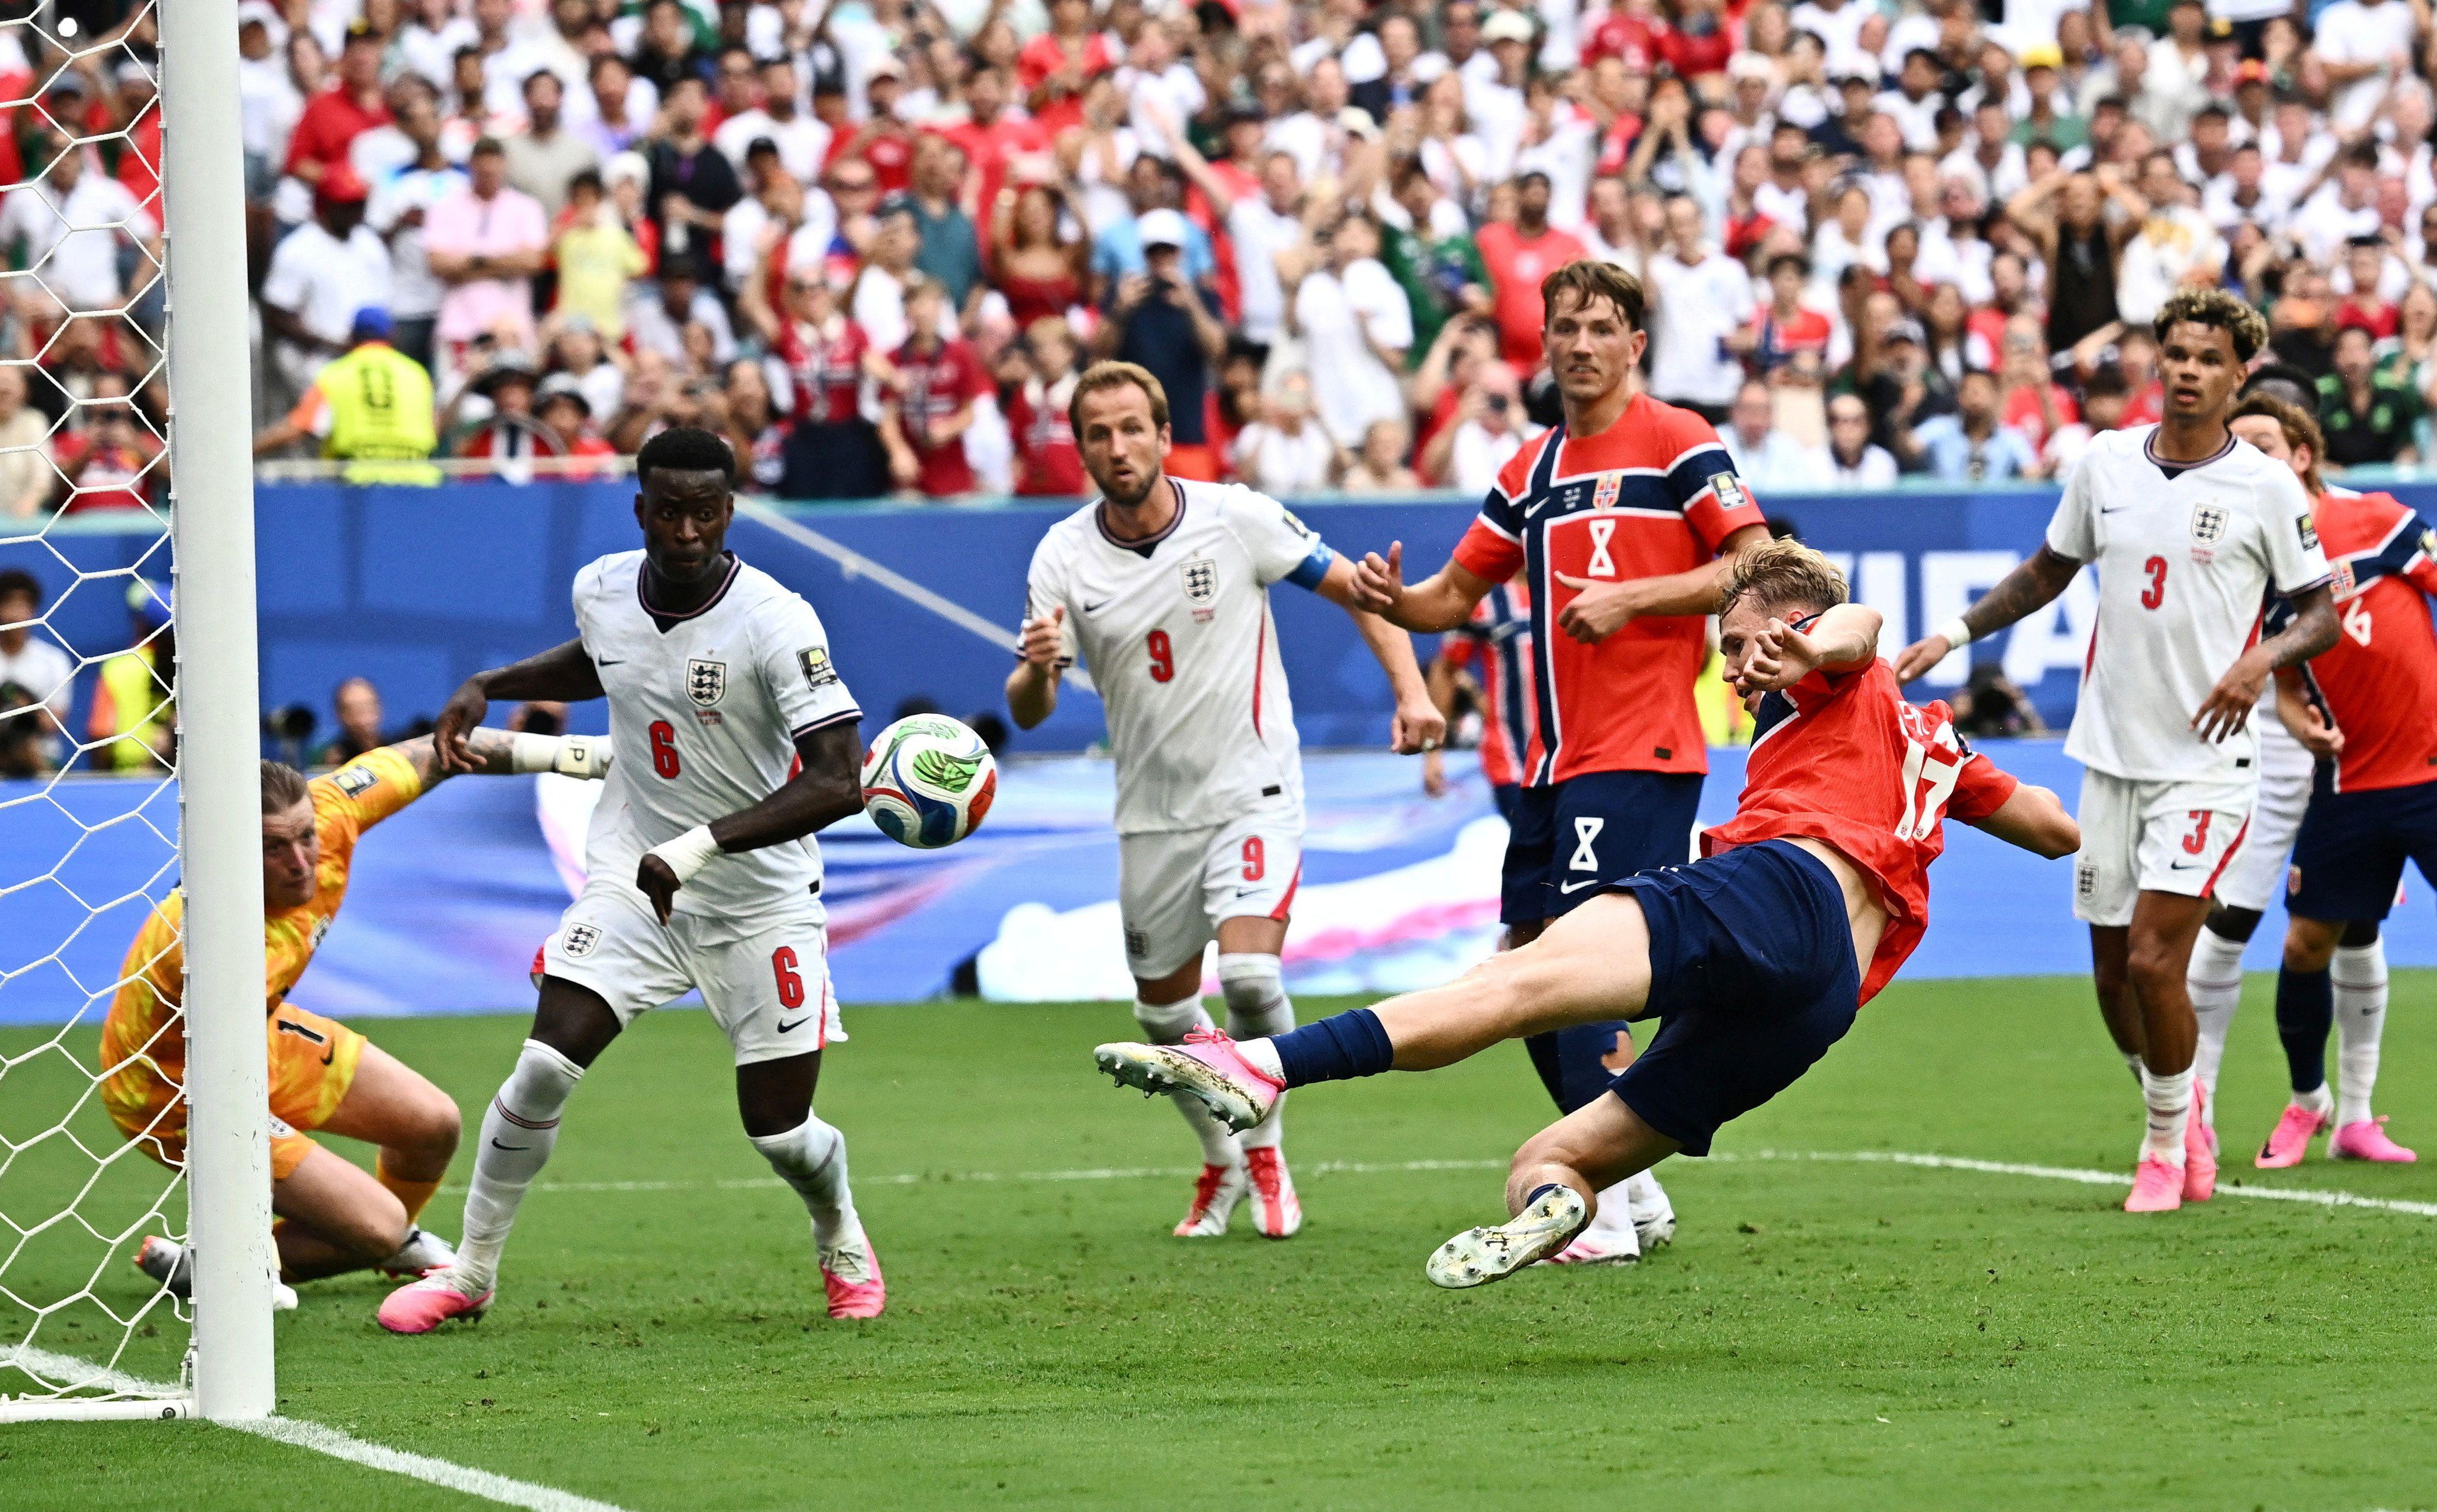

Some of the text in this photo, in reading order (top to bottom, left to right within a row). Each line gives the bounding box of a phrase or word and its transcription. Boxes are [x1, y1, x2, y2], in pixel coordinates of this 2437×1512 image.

[1588, 519, 1615, 576] 8
[2141, 556, 2169, 610] 3
[1817, 550, 2101, 687] IFA
[2343, 596, 2372, 646] 6
[1147, 628, 1175, 683] 9
[648, 720, 681, 779] 6
[1242, 835, 1265, 881] 9
[1569, 816, 1604, 872] 8
[2182, 810, 2213, 855] 3
[772, 946, 805, 1009] 6
[278, 1018, 328, 1045] 1
